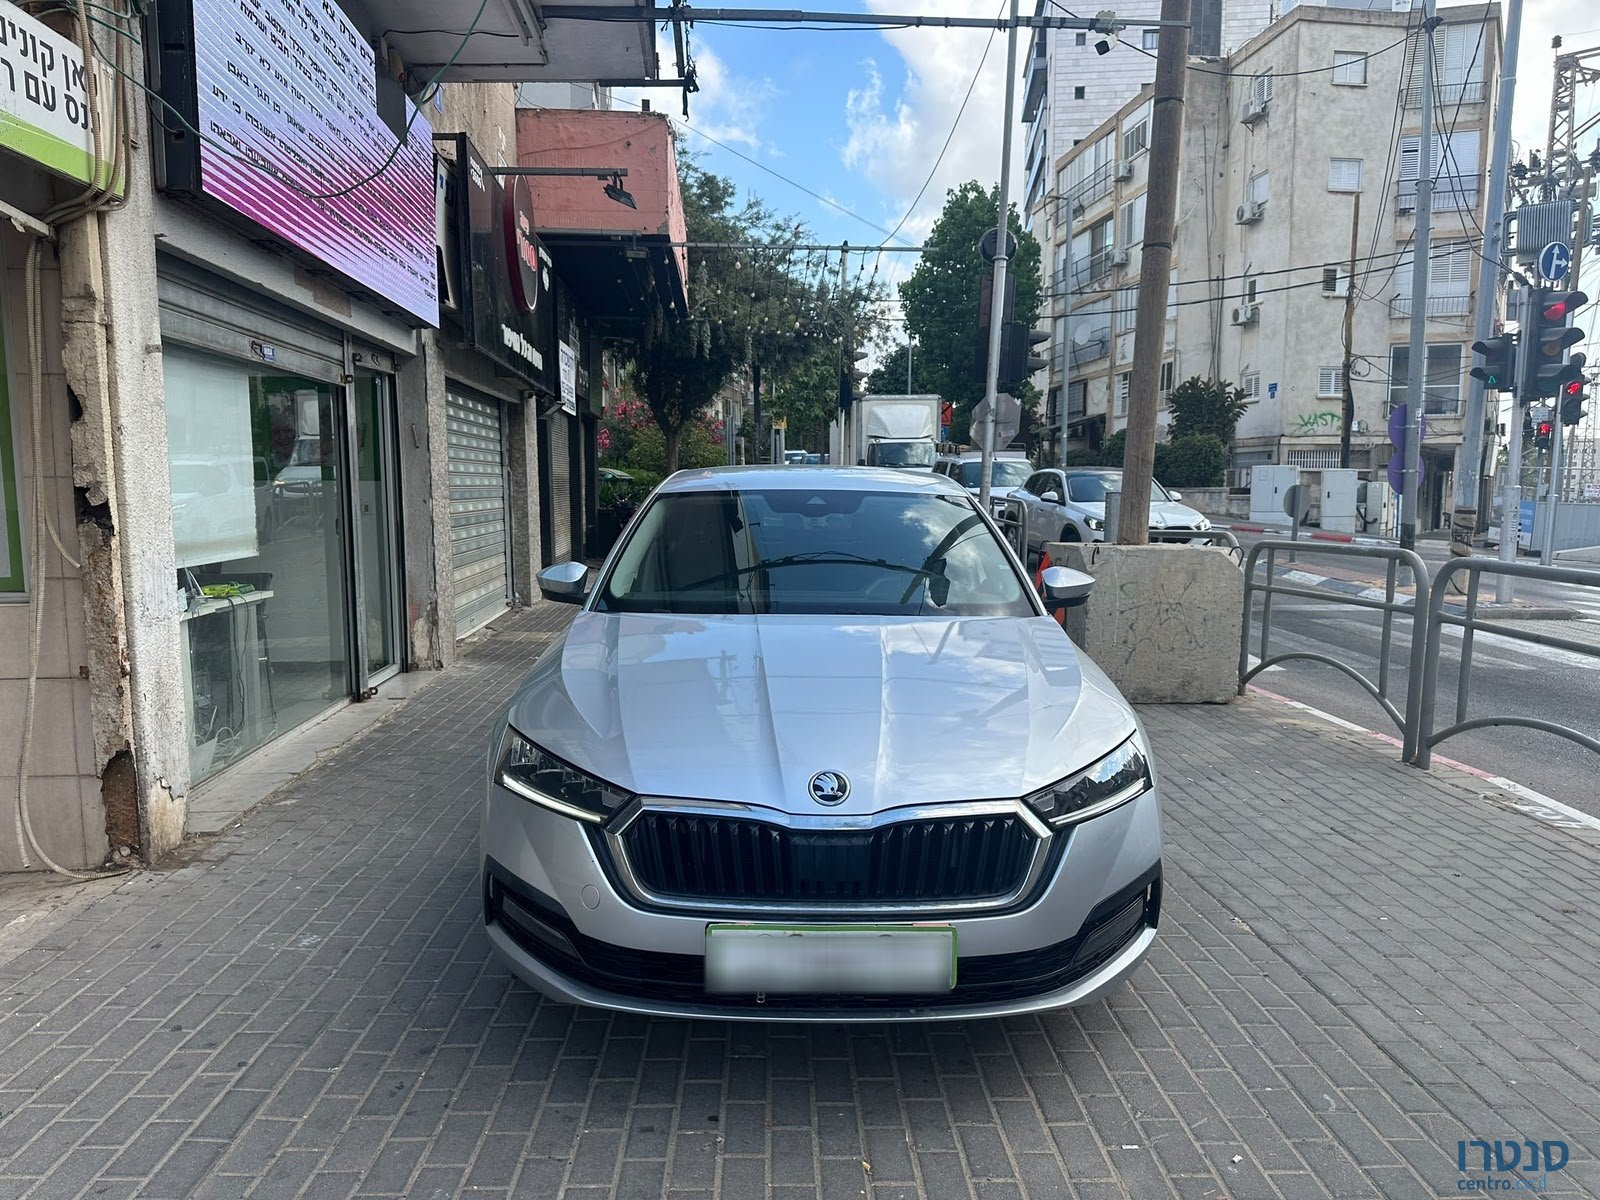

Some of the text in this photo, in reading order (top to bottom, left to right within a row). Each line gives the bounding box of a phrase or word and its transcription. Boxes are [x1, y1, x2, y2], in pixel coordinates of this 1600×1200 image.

[297, 11, 307, 30] לך
[322, 0, 335, 22] צא
[339, 18, 356, 49] פרק
[227, 60, 249, 87] באבן
[259, 54, 270, 71] לא
[308, 55, 326, 81] באפל
[62, 53, 97, 97] אן
[24, 70, 56, 112] עם
[212, 84, 227, 103] ידע
[290, 85, 305, 104] רעה
[64, 93, 100, 133] נס
[232, 100, 240, 113] כי
[272, 100, 280, 114] פן
